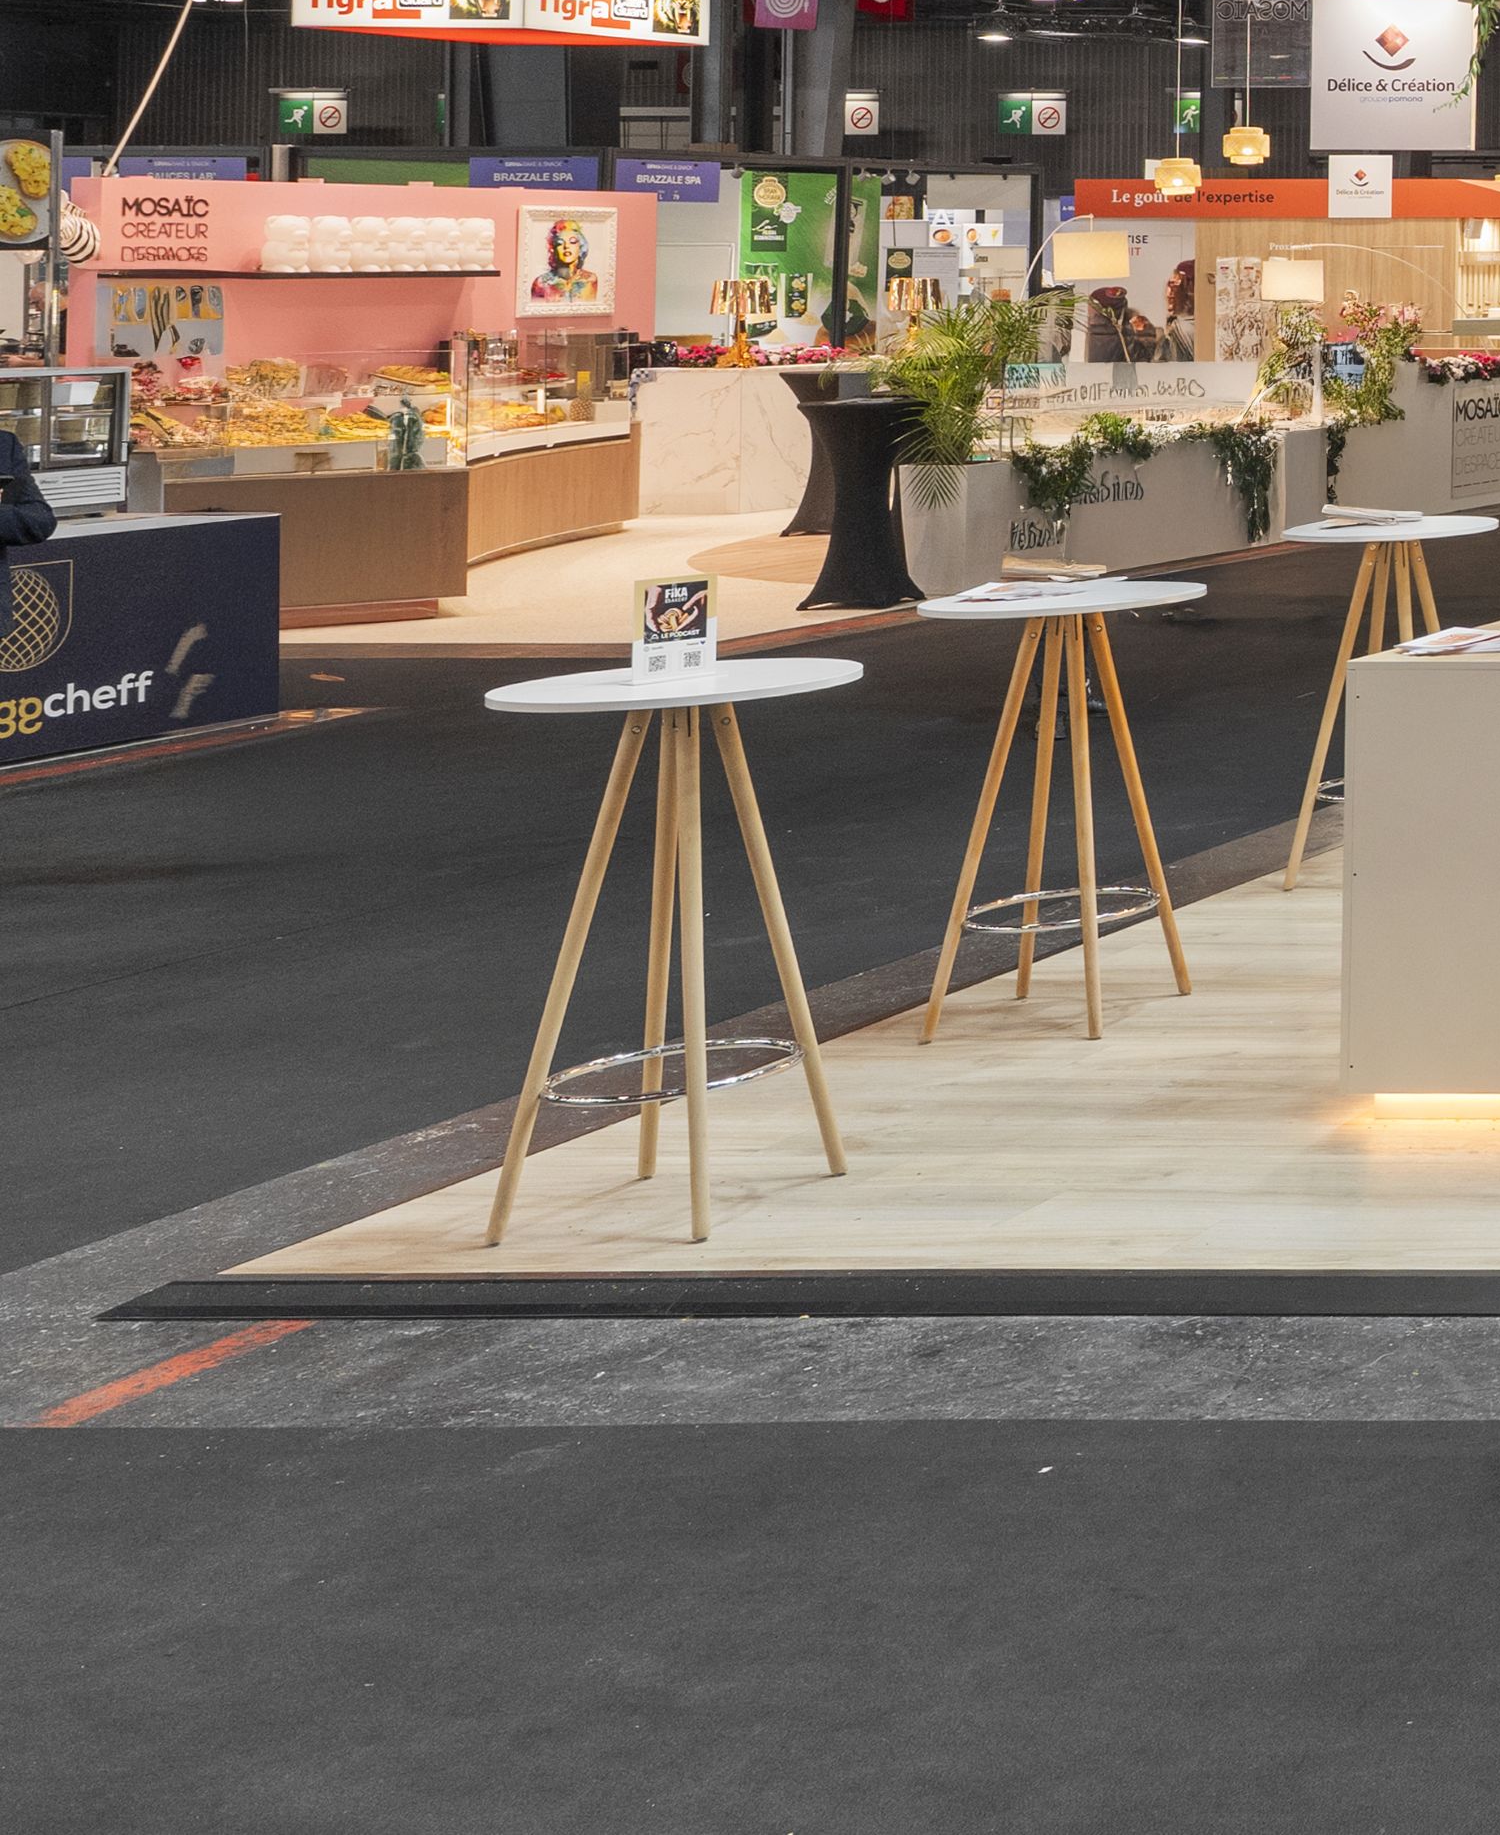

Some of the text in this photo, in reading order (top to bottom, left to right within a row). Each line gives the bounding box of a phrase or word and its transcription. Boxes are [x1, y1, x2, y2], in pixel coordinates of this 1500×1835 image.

[614, 4, 649, 19] Guard
[1327, 77, 1456, 93] Délice & Création
[1360, 96, 1388, 105] groupe
[493, 172, 573, 183] BRAZZALE SPA
[636, 174, 702, 185] BRAZZALE SPA
[1112, 188, 1132, 204] Le
[1174, 191, 1192, 204] de
[1197, 190, 1275, 206] l'expertise
[121, 195, 210, 217] MOSAÏC
[121, 221, 209, 239] CRÉATEUR
[661, 628, 701, 639] LE PODCAST
